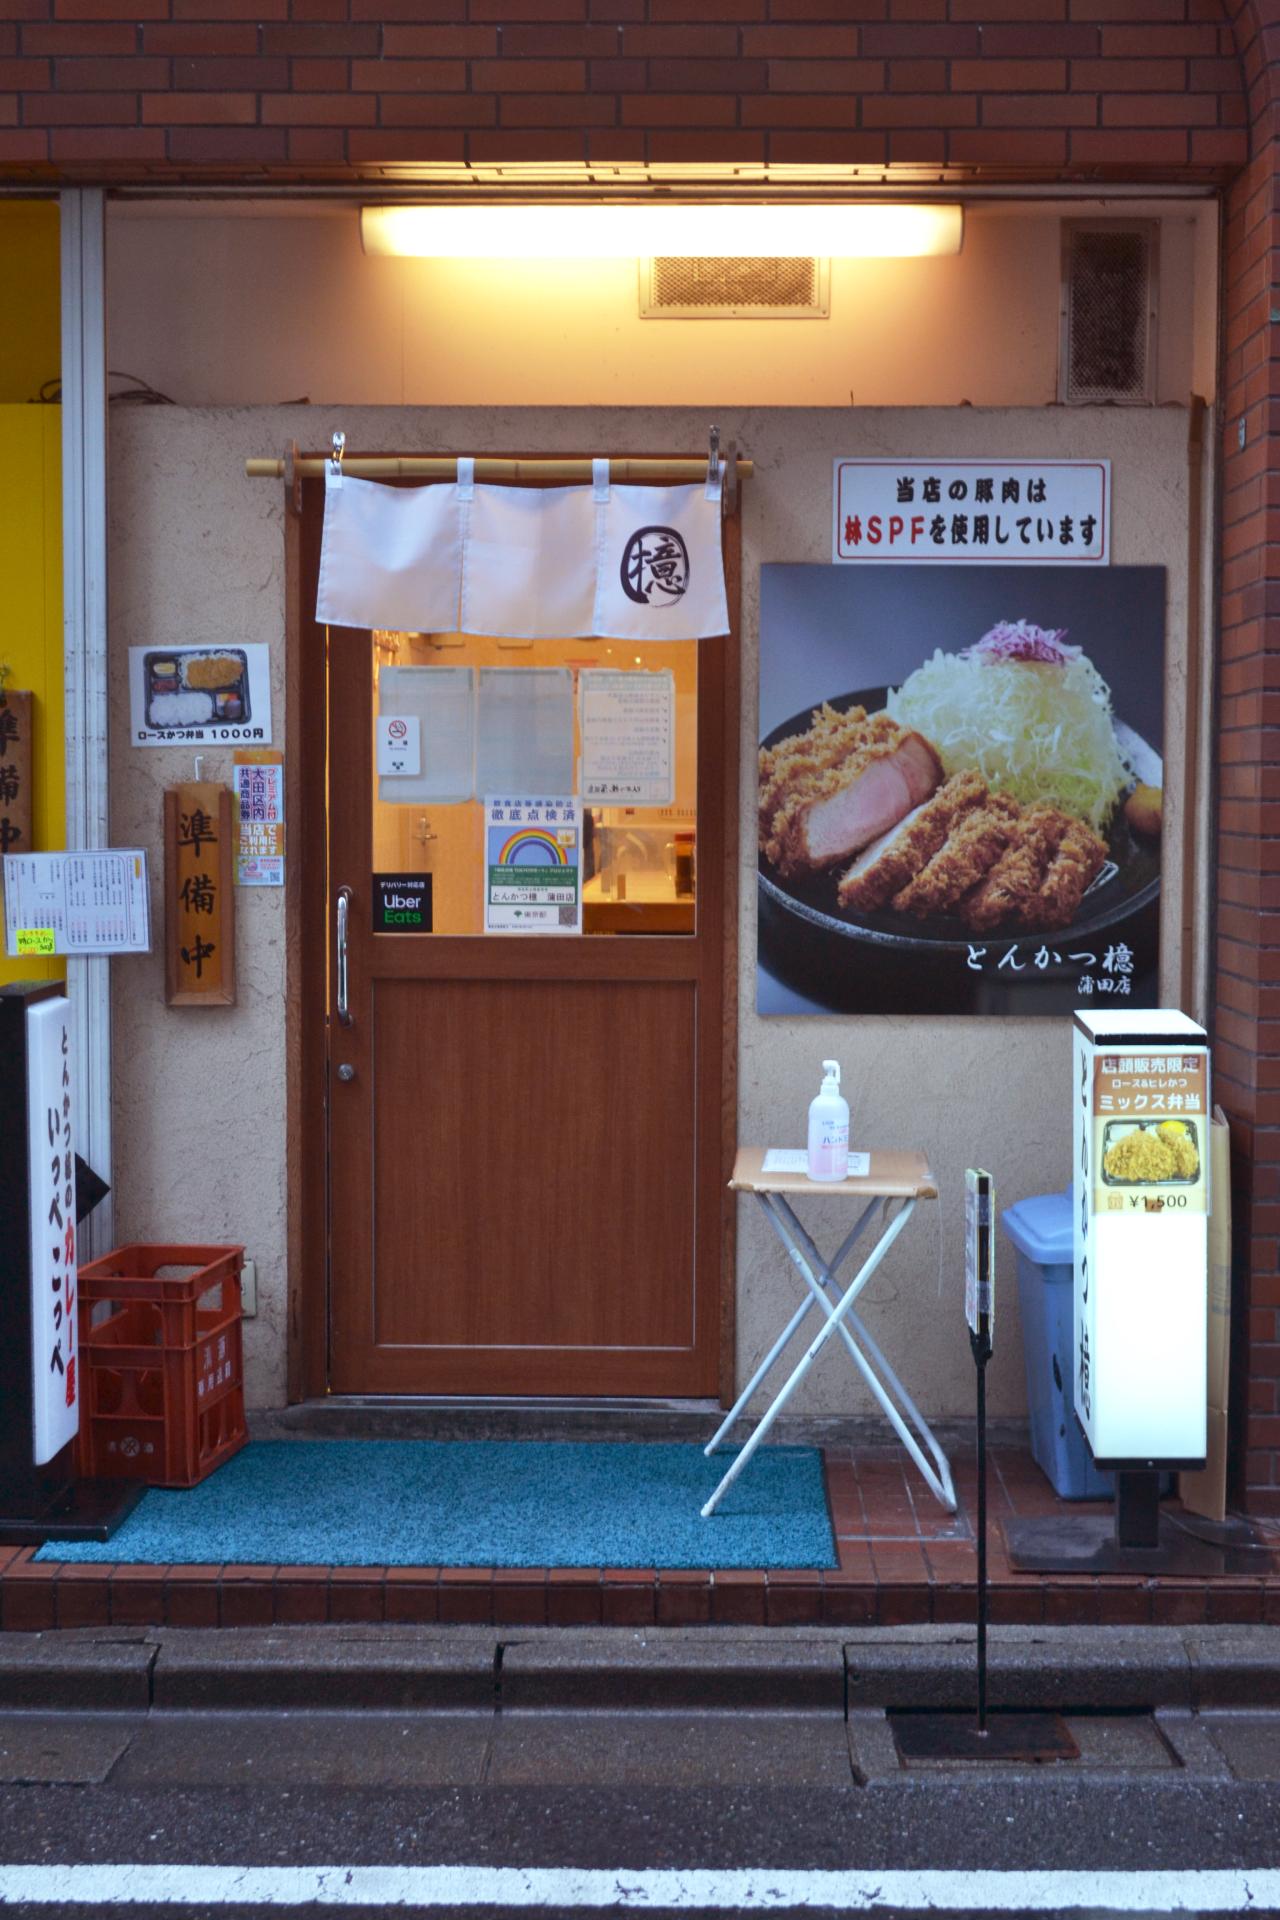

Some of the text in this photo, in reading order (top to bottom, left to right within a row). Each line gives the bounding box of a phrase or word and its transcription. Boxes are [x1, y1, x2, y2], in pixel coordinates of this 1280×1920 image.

[896, 477, 1047, 504] 当店の豚肉は
[845, 514, 1097, 546] 林SPFを使用しています
[138, 728, 264, 740] ロースかつ弁当 1000円
[240, 768, 250, 820] 共通商品券
[252, 768, 265, 820] 大田区内
[267, 767, 277, 820] プレミアム付
[491, 809, 575, 821] 徹底点検済
[240, 823, 276, 836] 当店で
[177, 808, 218, 979] 準備中
[384, 894, 421, 908] Uber
[547, 892, 575, 902] 蒲田店
[384, 910, 421, 923] Eats
[967, 942, 1135, 973] とんかつ檍
[1078, 975, 1132, 995] 蒲田店
[1101, 1056, 1200, 1073] 店頭販売限定
[1100, 1093, 1201, 1110] ミックス弁当
[1130, 1194, 1188, 1209] ¥1,500
